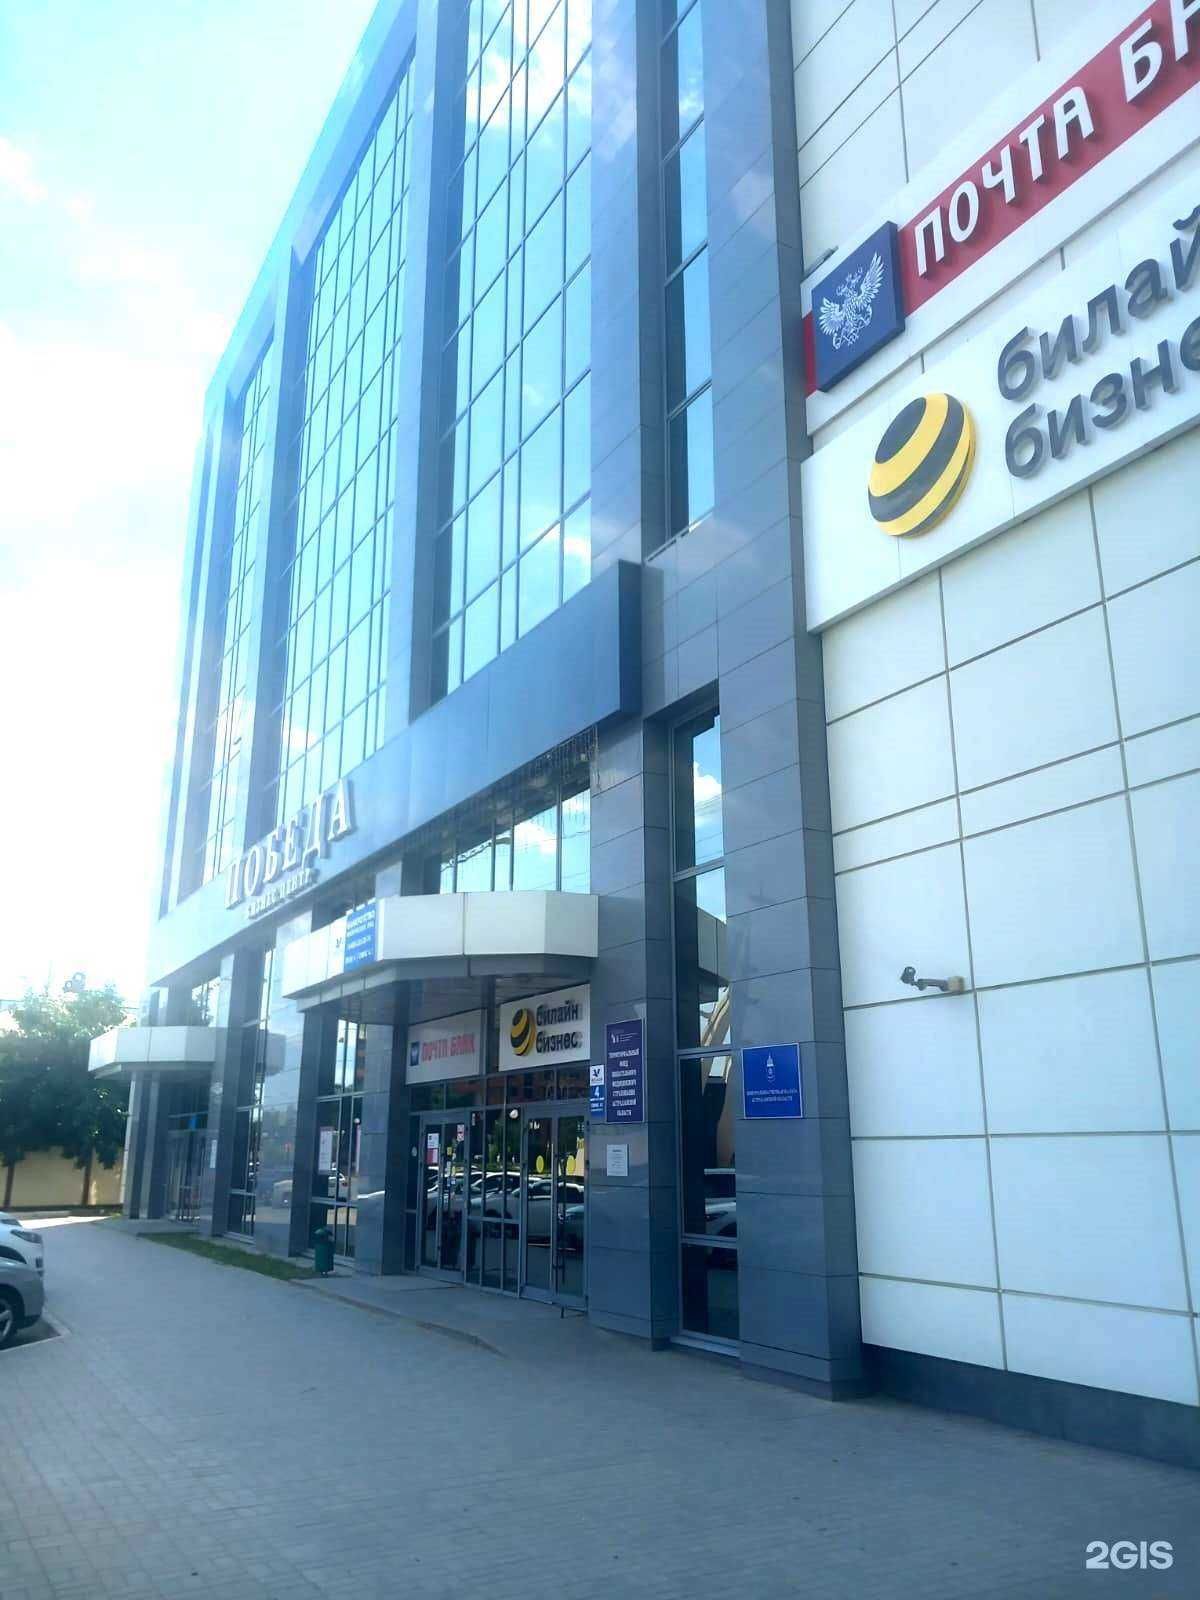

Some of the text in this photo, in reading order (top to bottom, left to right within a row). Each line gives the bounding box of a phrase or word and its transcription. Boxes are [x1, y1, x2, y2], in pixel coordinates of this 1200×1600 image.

[914, 86, 1095, 277] ПОЧТА
[225, 779, 353, 909] ПОБЕДА
[536, 1000, 580, 1027] билайн
[536, 1031, 580, 1053] бизнес
